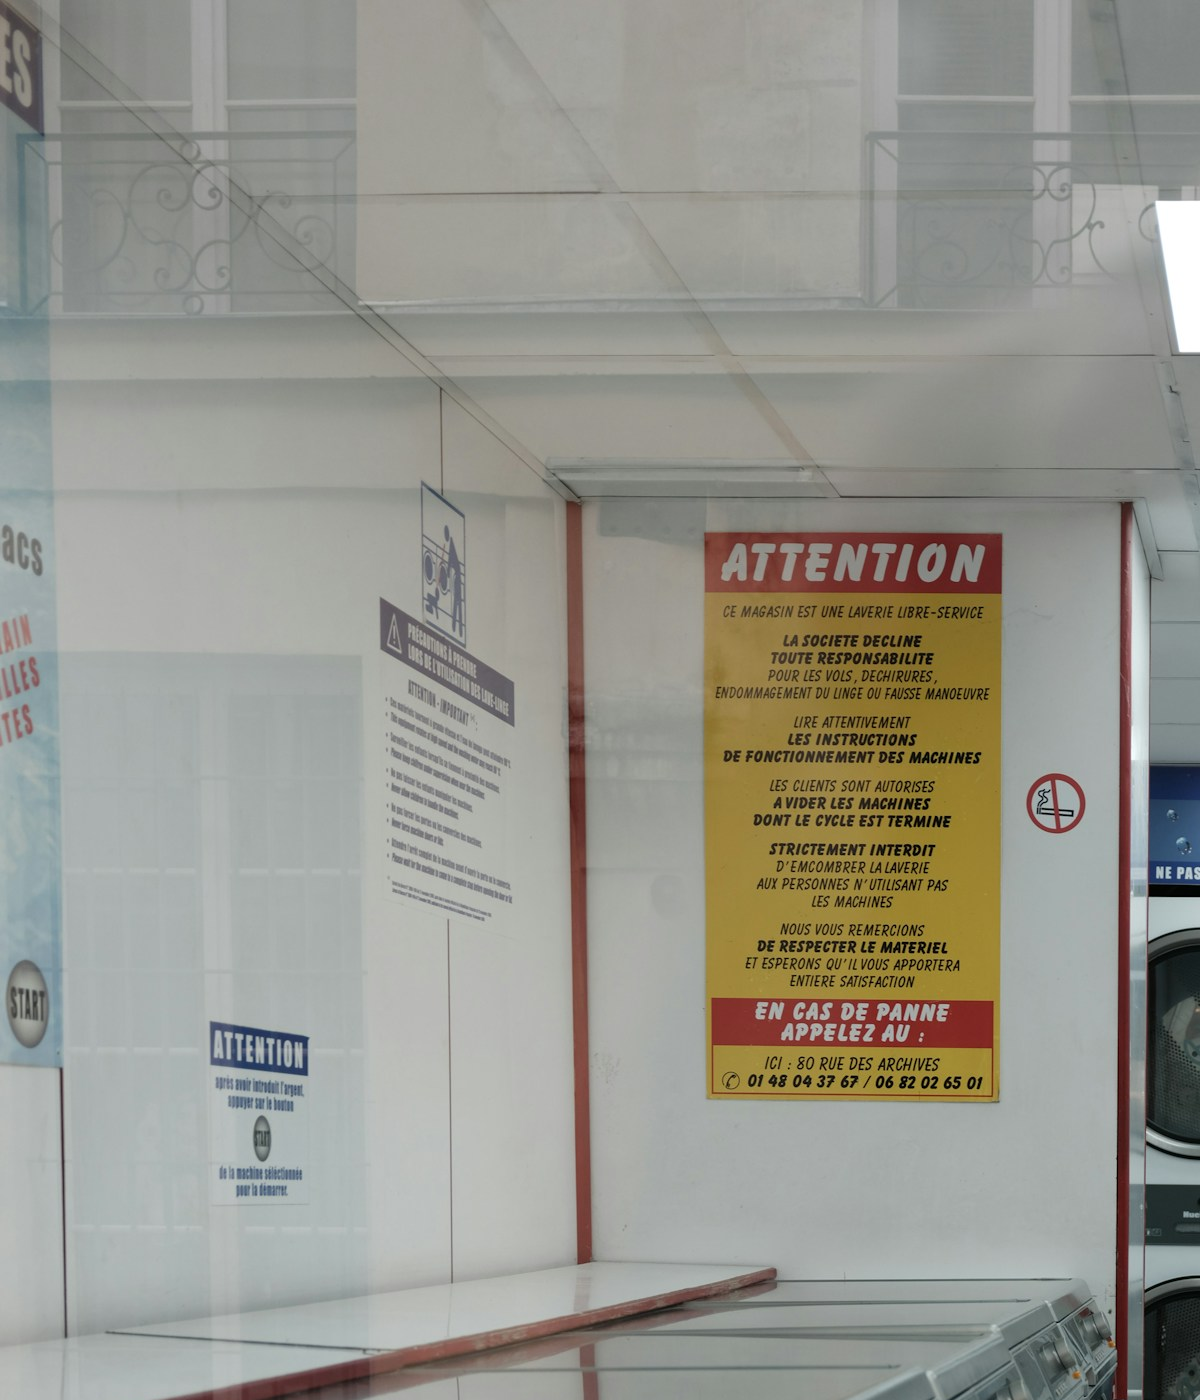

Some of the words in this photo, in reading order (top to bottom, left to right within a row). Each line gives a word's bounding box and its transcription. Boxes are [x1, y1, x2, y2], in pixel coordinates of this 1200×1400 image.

[720, 543, 985, 582] ATTENTION
[723, 605, 737, 617] CE
[741, 606, 794, 617] MAGASIN
[798, 606, 817, 617] EST
[822, 606, 844, 618] UNE
[849, 606, 893, 618] LAVERIE
[898, 606, 984, 619] LIBRE-SERVICE
[783, 635, 798, 647] LA
[802, 635, 859, 647] SOCIETE
[863, 635, 922, 647] DECLINE
[408, 622, 448, 661] PRÉCAUTIONS
[447, 645, 454, 665] À
[453, 651, 477, 679] PRENDRE
[771, 652, 813, 664] TOUTE
[818, 652, 934, 665] RESPONSABILITE
[408, 643, 424, 667] LORS
[424, 653, 433, 671] DE
[432, 657, 470, 694] L'UTILISATION
[471, 681, 481, 700] DES
[481, 687, 509, 717] LAVE-LINGE
[715, 687, 812, 699] ENDOMMAGEMENT
[816, 687, 830, 699] DU
[834, 687, 863, 699] LINGE
[867, 687, 881, 699] OU
[885, 688, 921, 699] FAUSSE
[925, 688, 989, 700] MANOEUVRE
[408, 679, 436, 708] ATTENTION
[440, 698, 468, 727] IMPORTANT
[788, 733, 811, 745] LES
[816, 733, 917, 746] INSTRUCTIONS
[724, 750, 741, 762] DE
[746, 751, 875, 763] FONCTIONNEMENT
[879, 751, 905, 763] DES
[909, 752, 981, 764] MACHINES
[754, 814, 791, 826] DONT
[795, 815, 811, 826] LE
[816, 815, 855, 827] CYCLE
[859, 815, 884, 827] EST
[888, 815, 951, 828] TERMINE
[769, 843, 866, 856] STRICTEMENT
[870, 844, 935, 857] INTERDIT
[1155, 866, 1173, 880] NE
[780, 923, 811, 935] NOUS
[816, 924, 844, 935] VOUS
[848, 924, 924, 936] REMERCIONS
[758, 940, 775, 952] DE
[780, 940, 856, 953] RESPECTER
[861, 941, 876, 953] LE
[880, 942, 947, 954] MATERIEL
[9, 980, 46, 1025] START
[754, 1002, 784, 1023] EN
[792, 1002, 831, 1023] CAS
[840, 1002, 868, 1023] DE
[876, 1002, 951, 1023] PANNE
[781, 1023, 874, 1041] APPELEZ
[881, 1024, 910, 1042] AU
[213, 1029, 304, 1069] ATTENTION
[765, 1056, 782, 1069] ICI
[797, 1057, 814, 1070] 80
[820, 1057, 844, 1071] RUE
[849, 1057, 873, 1070] DES
[878, 1058, 940, 1071] ARCHIVES
[215, 1075, 234, 1090] après
[235, 1078, 252, 1092] avoir
[252, 1078, 280, 1095] introduit
[748, 1074, 763, 1087] 01
[768, 1075, 787, 1087] 48
[793, 1075, 812, 1087] 04
[817, 1075, 835, 1088] 37
[841, 1076, 858, 1088] 67
[876, 1076, 893, 1088] 06
[899, 1076, 916, 1089] 82
[922, 1076, 938, 1089] 02
[944, 1077, 961, 1089] 65
[967, 1077, 982, 1089] 01
[227, 1095, 254, 1110] appuyer
[255, 1097, 265, 1110] sur
[266, 1096, 272, 1111] le
[273, 1097, 294, 1112] bouton
[219, 1165, 227, 1180] de
[228, 1165, 235, 1180] la
[236, 1165, 264, 1181] machine
[235, 1184, 250, 1197] pour
[251, 1183, 258, 1197] la
